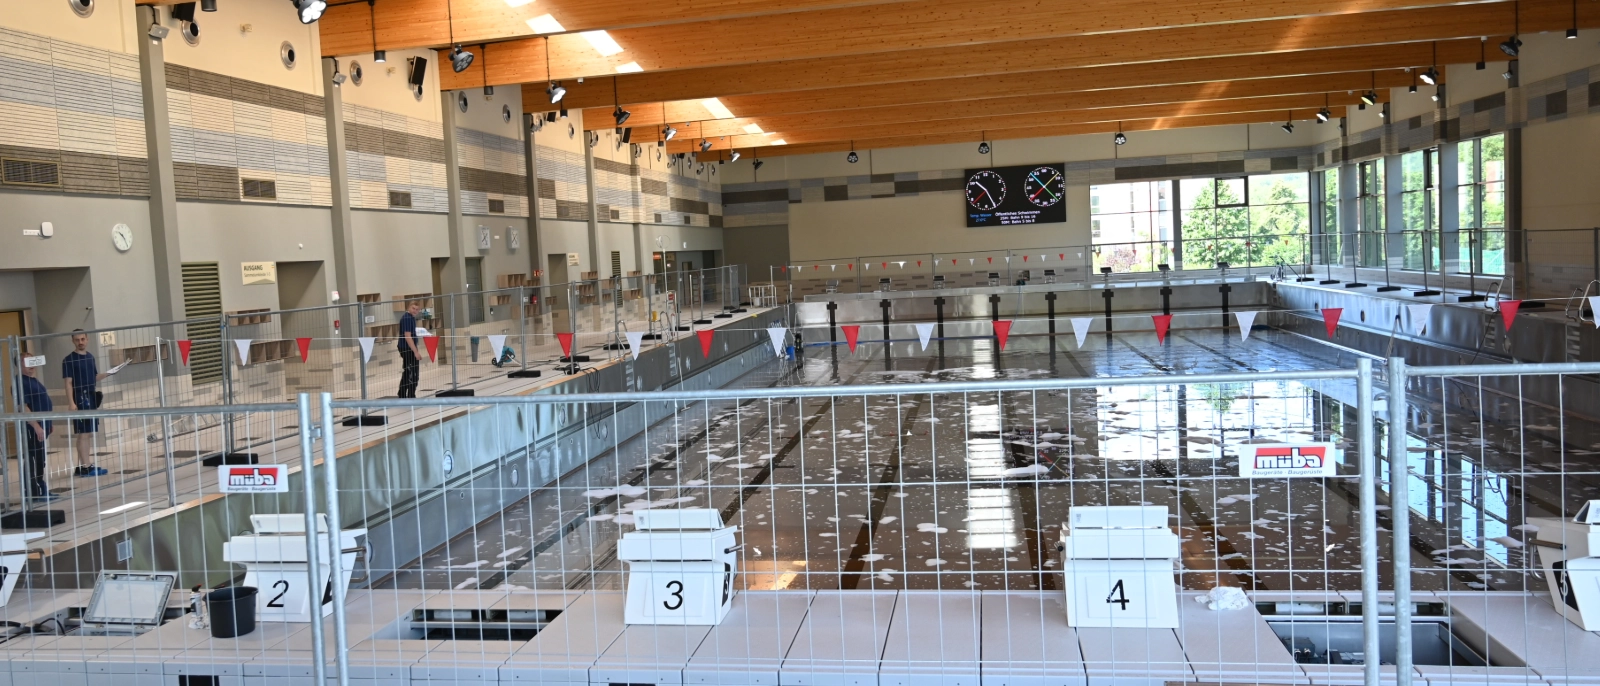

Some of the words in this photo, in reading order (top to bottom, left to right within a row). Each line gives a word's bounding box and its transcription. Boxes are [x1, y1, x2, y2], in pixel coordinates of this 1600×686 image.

[1256, 447, 1322, 468] müba
[230, 468, 275, 485] müba
[266, 580, 289, 608] 2
[663, 580, 683, 610] 3
[1106, 579, 1130, 610] 4
[1560, 570, 1569, 596] 5
